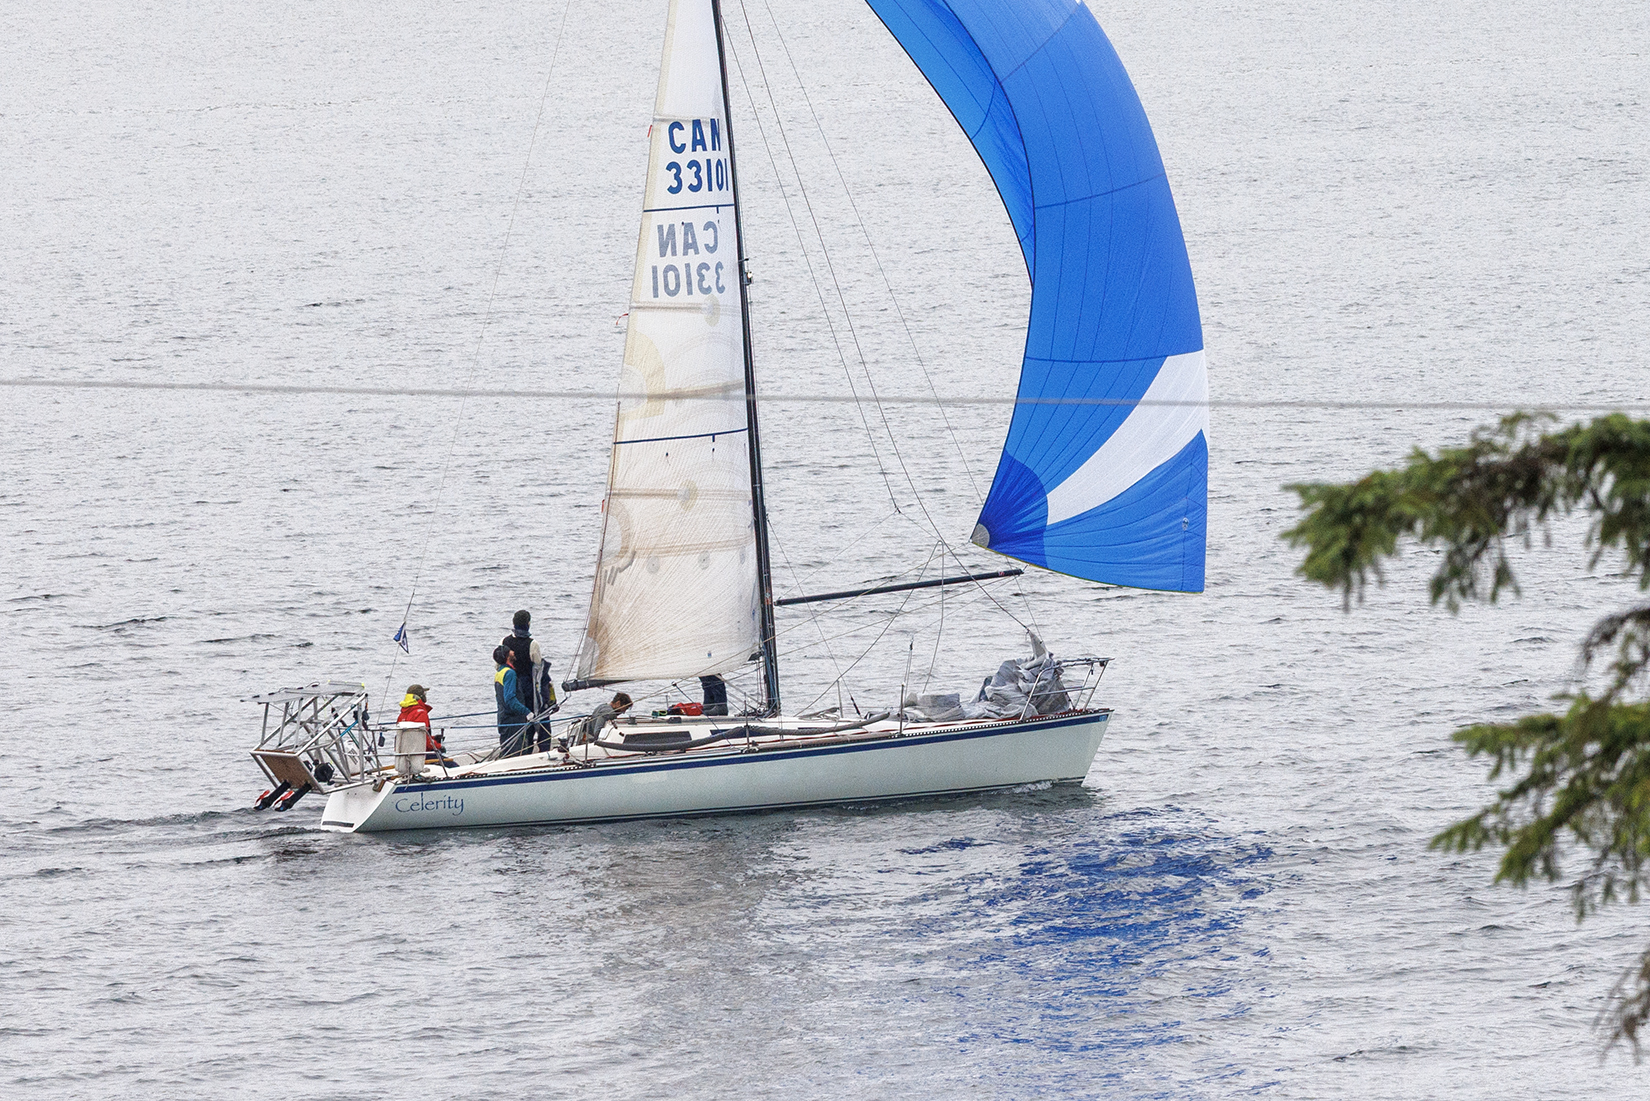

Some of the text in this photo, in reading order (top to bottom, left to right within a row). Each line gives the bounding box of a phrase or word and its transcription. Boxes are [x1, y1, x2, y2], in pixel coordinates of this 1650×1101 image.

[668, 118, 720, 154] CAN
[666, 158, 728, 194] 33101
[395, 792, 463, 816] Celerity
